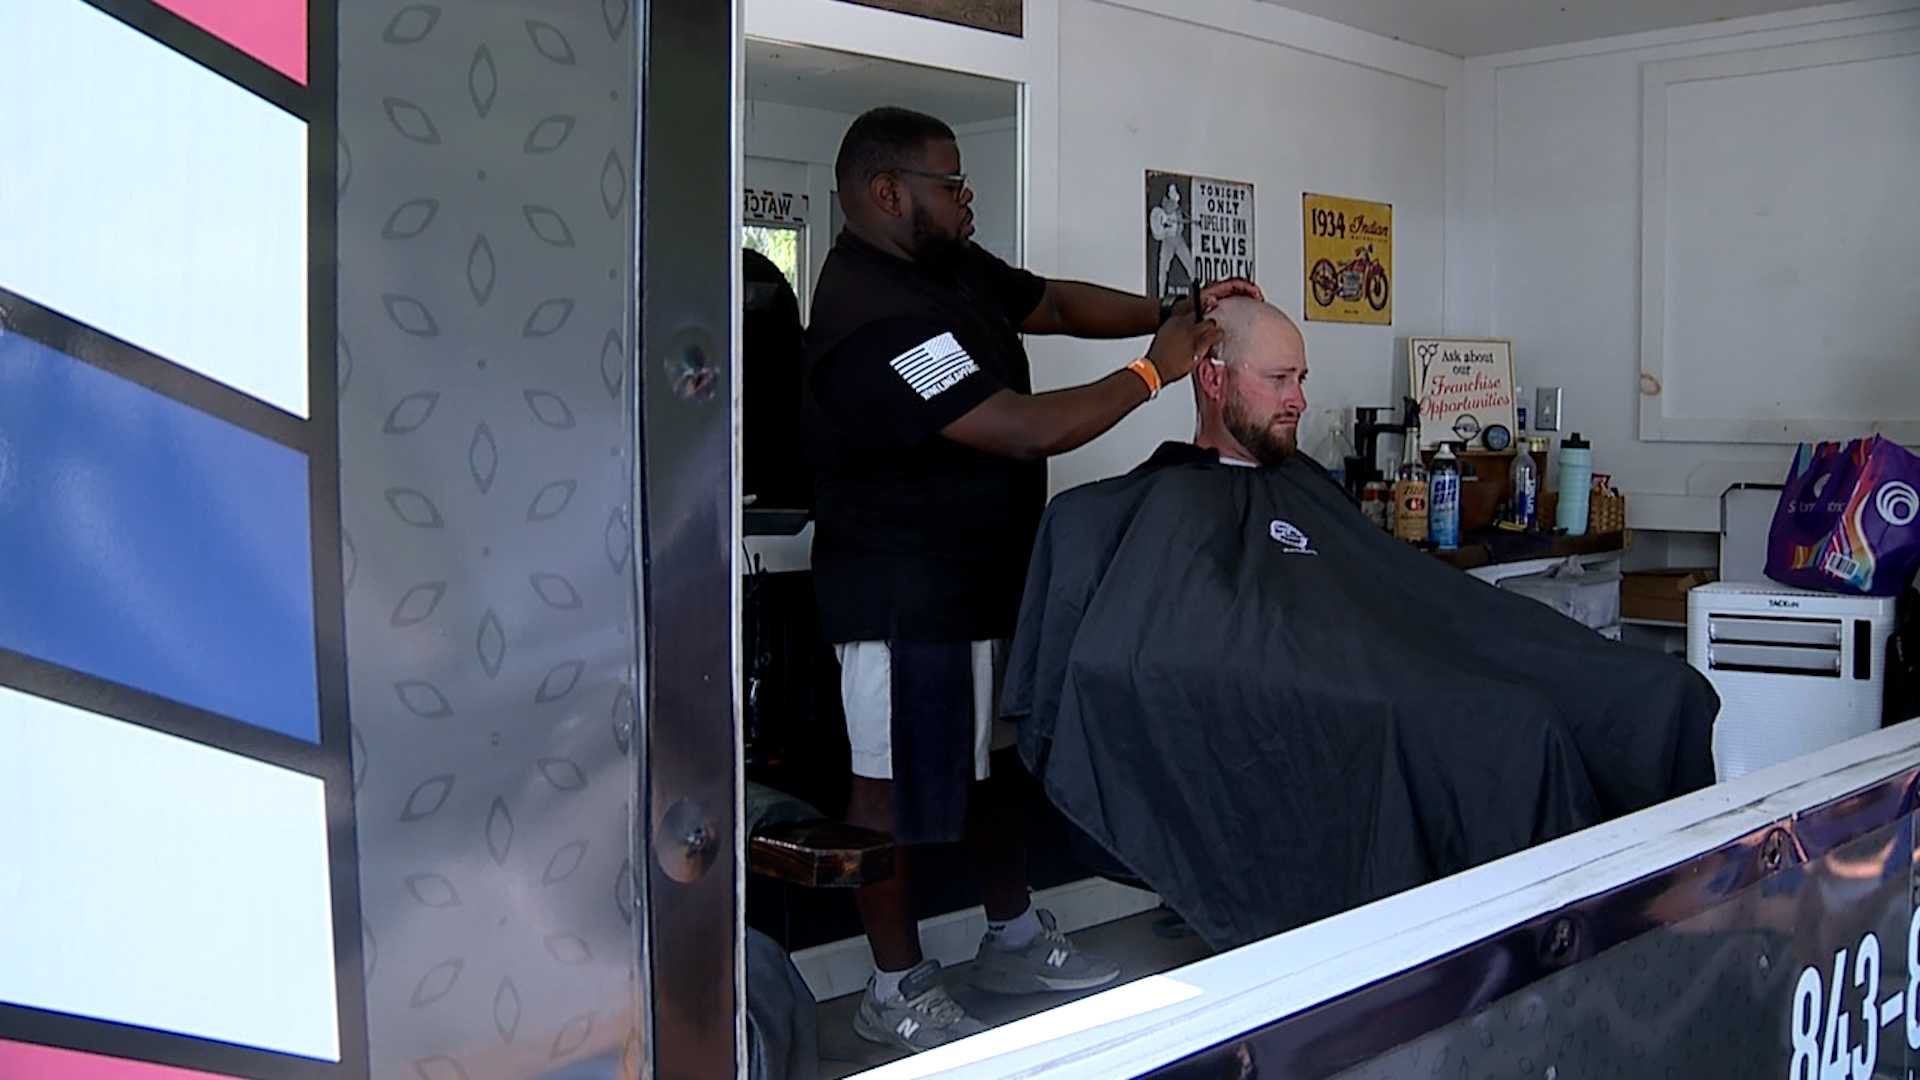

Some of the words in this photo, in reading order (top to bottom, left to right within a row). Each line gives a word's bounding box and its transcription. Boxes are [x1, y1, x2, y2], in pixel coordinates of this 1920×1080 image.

[1200, 184, 1246, 201] TONIGHT
[1207, 199, 1240, 216] ONLY
[1312, 207, 1346, 240] 1934
[1201, 233, 1247, 256] ELVIS
[1441, 350, 1461, 363] Ask
[1464, 350, 1494, 364] about
[1452, 364, 1472, 376] our
[1431, 371, 1502, 396] Franchise
[1418, 392, 1511, 421] Opportunities
[1047, 949, 1068, 968] N
[897, 1018, 919, 1039] N
